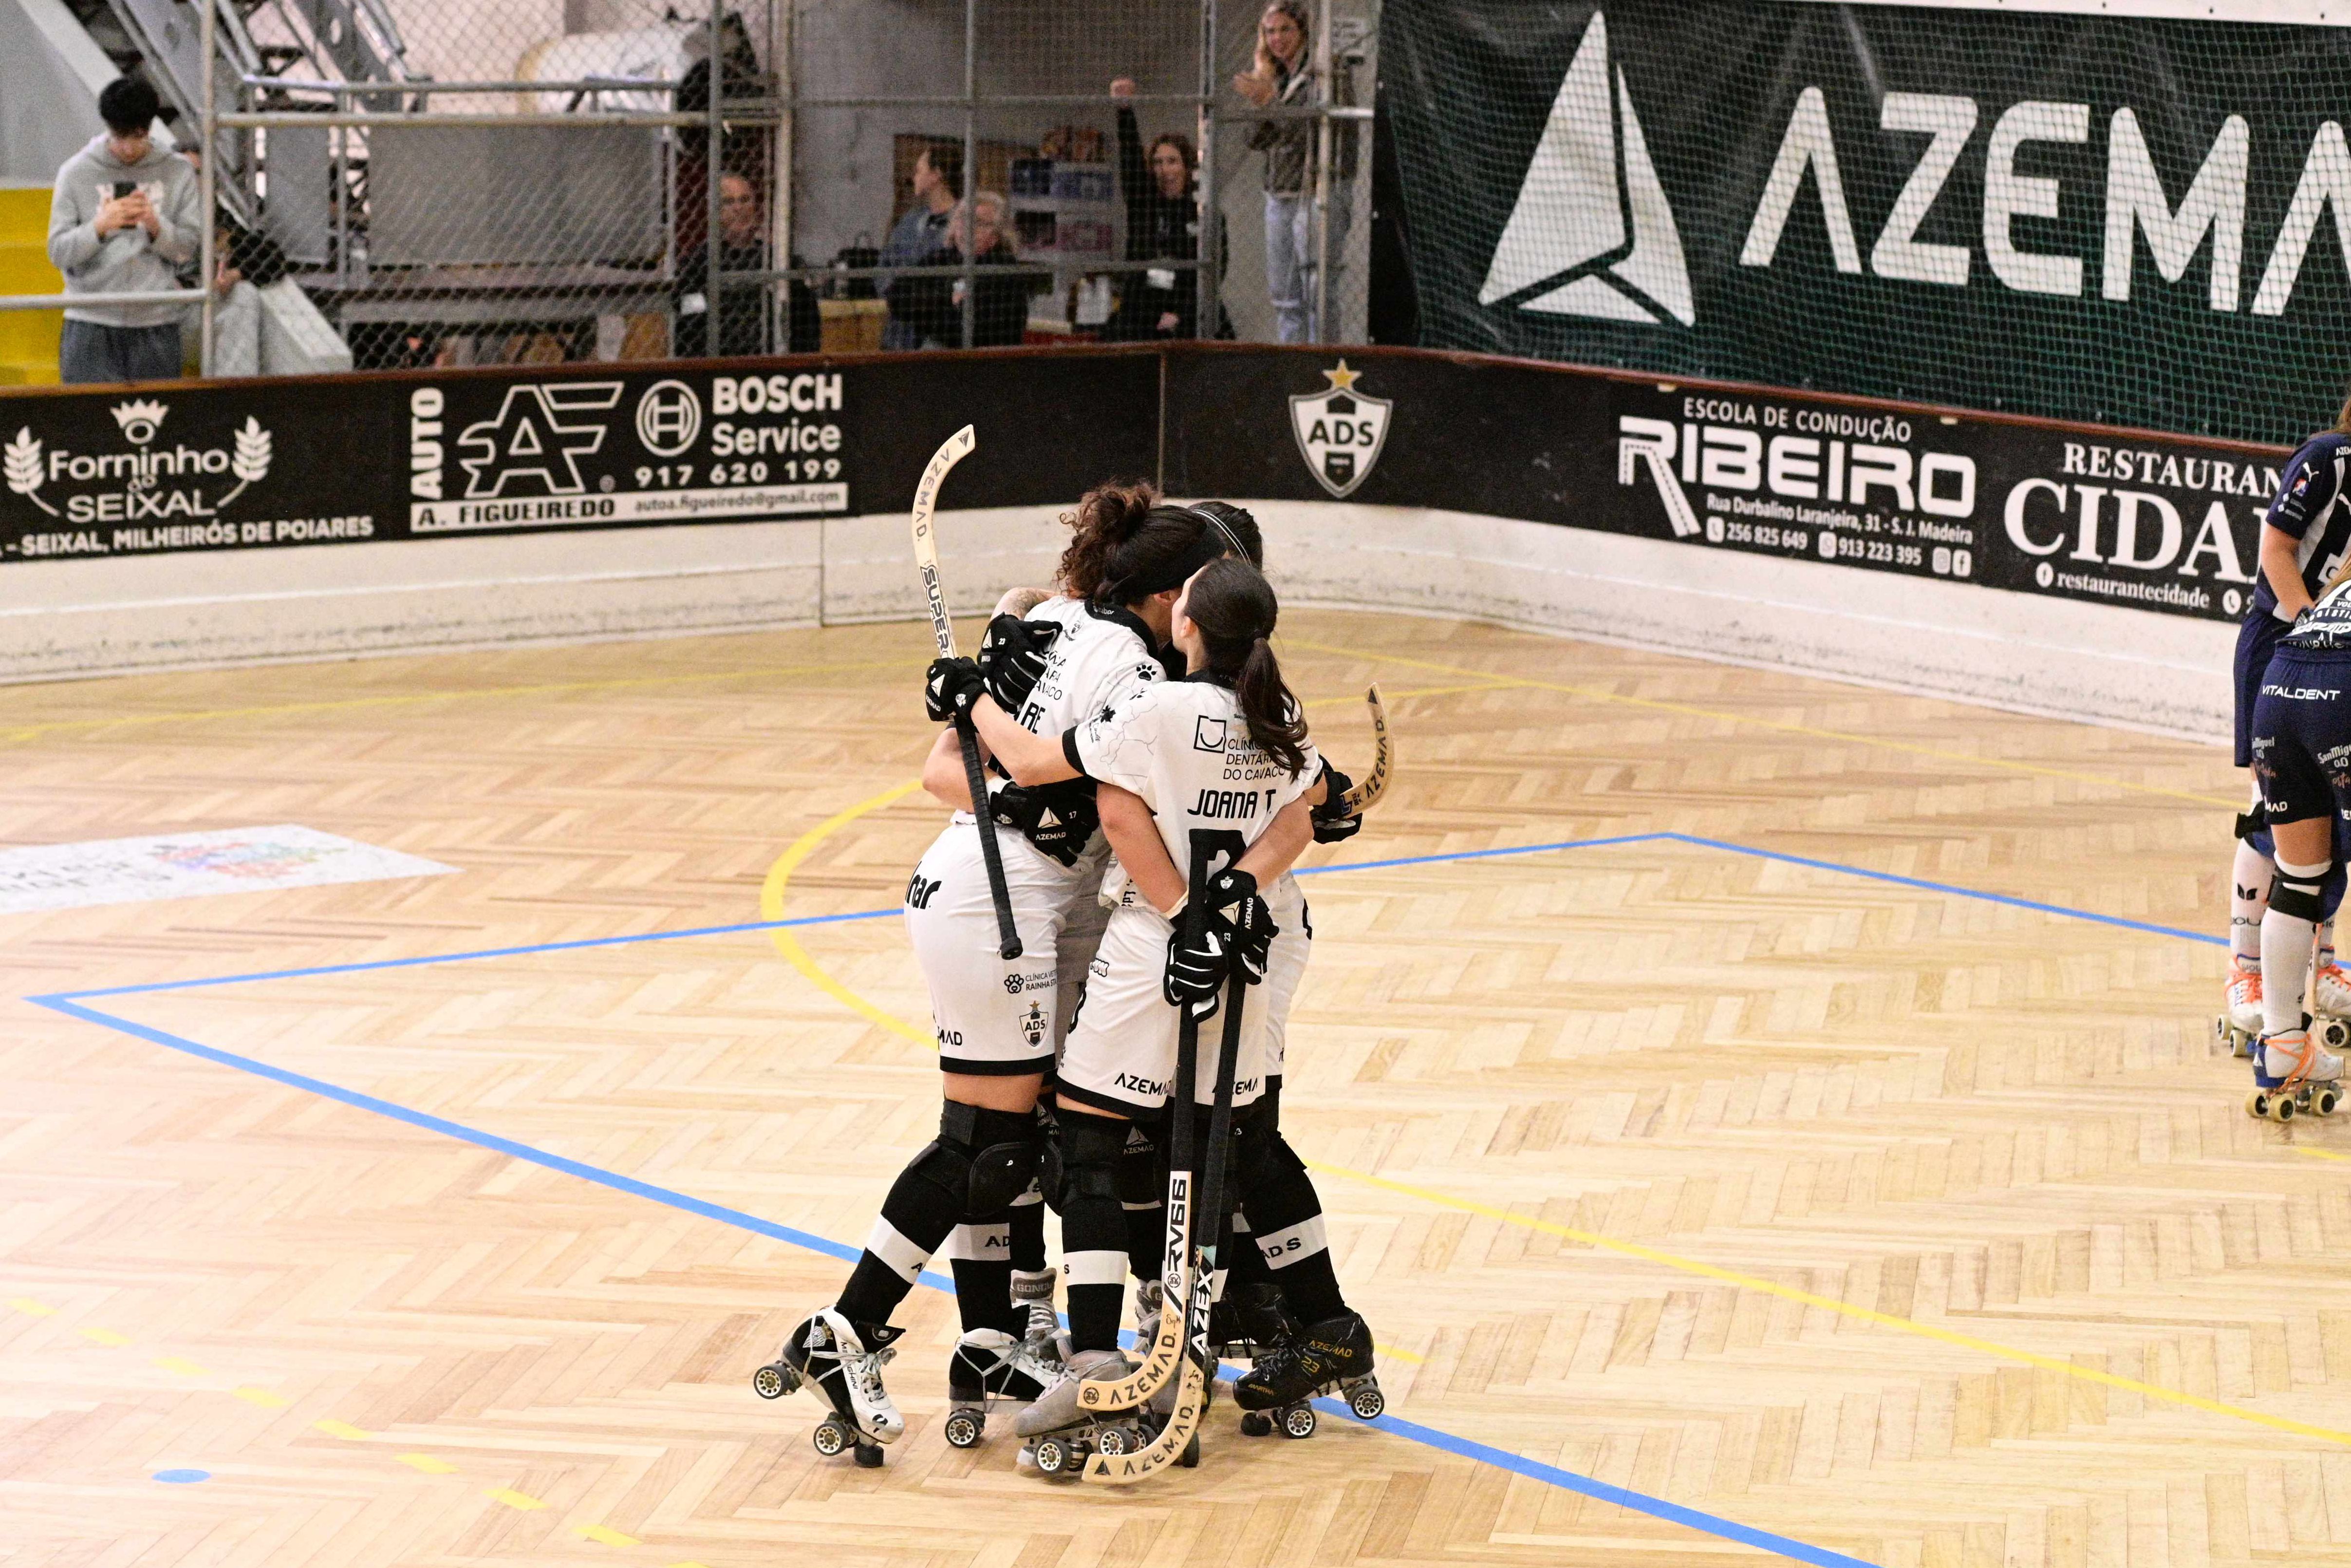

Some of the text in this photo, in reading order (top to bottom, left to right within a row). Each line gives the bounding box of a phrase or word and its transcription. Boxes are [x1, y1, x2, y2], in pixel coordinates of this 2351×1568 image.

[713, 373, 842, 415] BOSCH
[1308, 419, 1374, 447] ADS
[1684, 397, 1911, 445] ESCOLA DE CONDUÇÃO
[411, 387, 444, 500] AUTO
[712, 418, 842, 457] Service
[50, 445, 229, 482] Forninho
[635, 458, 842, 487] 917 620 199
[1618, 415, 1977, 537] RIBEIRO
[2064, 443, 2281, 499] RESTAURAN
[67, 489, 216, 523] SEIXAL
[460, 499, 616, 523] FIGUEIREDO
[1707, 494, 1731, 511] Rua
[1733, 496, 1794, 520] Durbalino
[1866, 517, 1881, 533] 31
[1919, 524, 1973, 544] Madeira
[113, 520, 237, 549] MILHEIRÓS
[243, 521, 273, 542] DE
[277, 516, 374, 540] POIARES
[1727, 523, 1808, 550] 256 825 649
[2004, 477, 2269, 584] CIDA
[1838, 539, 1922, 566] 913 223 395
[2057, 574, 2210, 609] restaurantecidade
[2262, 685, 2340, 701] VITALDENT
[1223, 766, 1286, 780] DO CAVACO
[1068, 811, 1077, 819] 17
[1187, 789, 1258, 819] JOANA
[1036, 832, 1066, 840] AZEMAD
[1245, 897, 1254, 930] AZEMAD
[1224, 933, 1231, 942] 23
[1026, 980, 1050, 991] RAINHA
[1025, 1019, 1045, 1032] ADS
[1123, 1145, 1155, 1156] AZEMAD
[1168, 1178, 1187, 1272] RV66
[1302, 1356, 1320, 1373] 23
